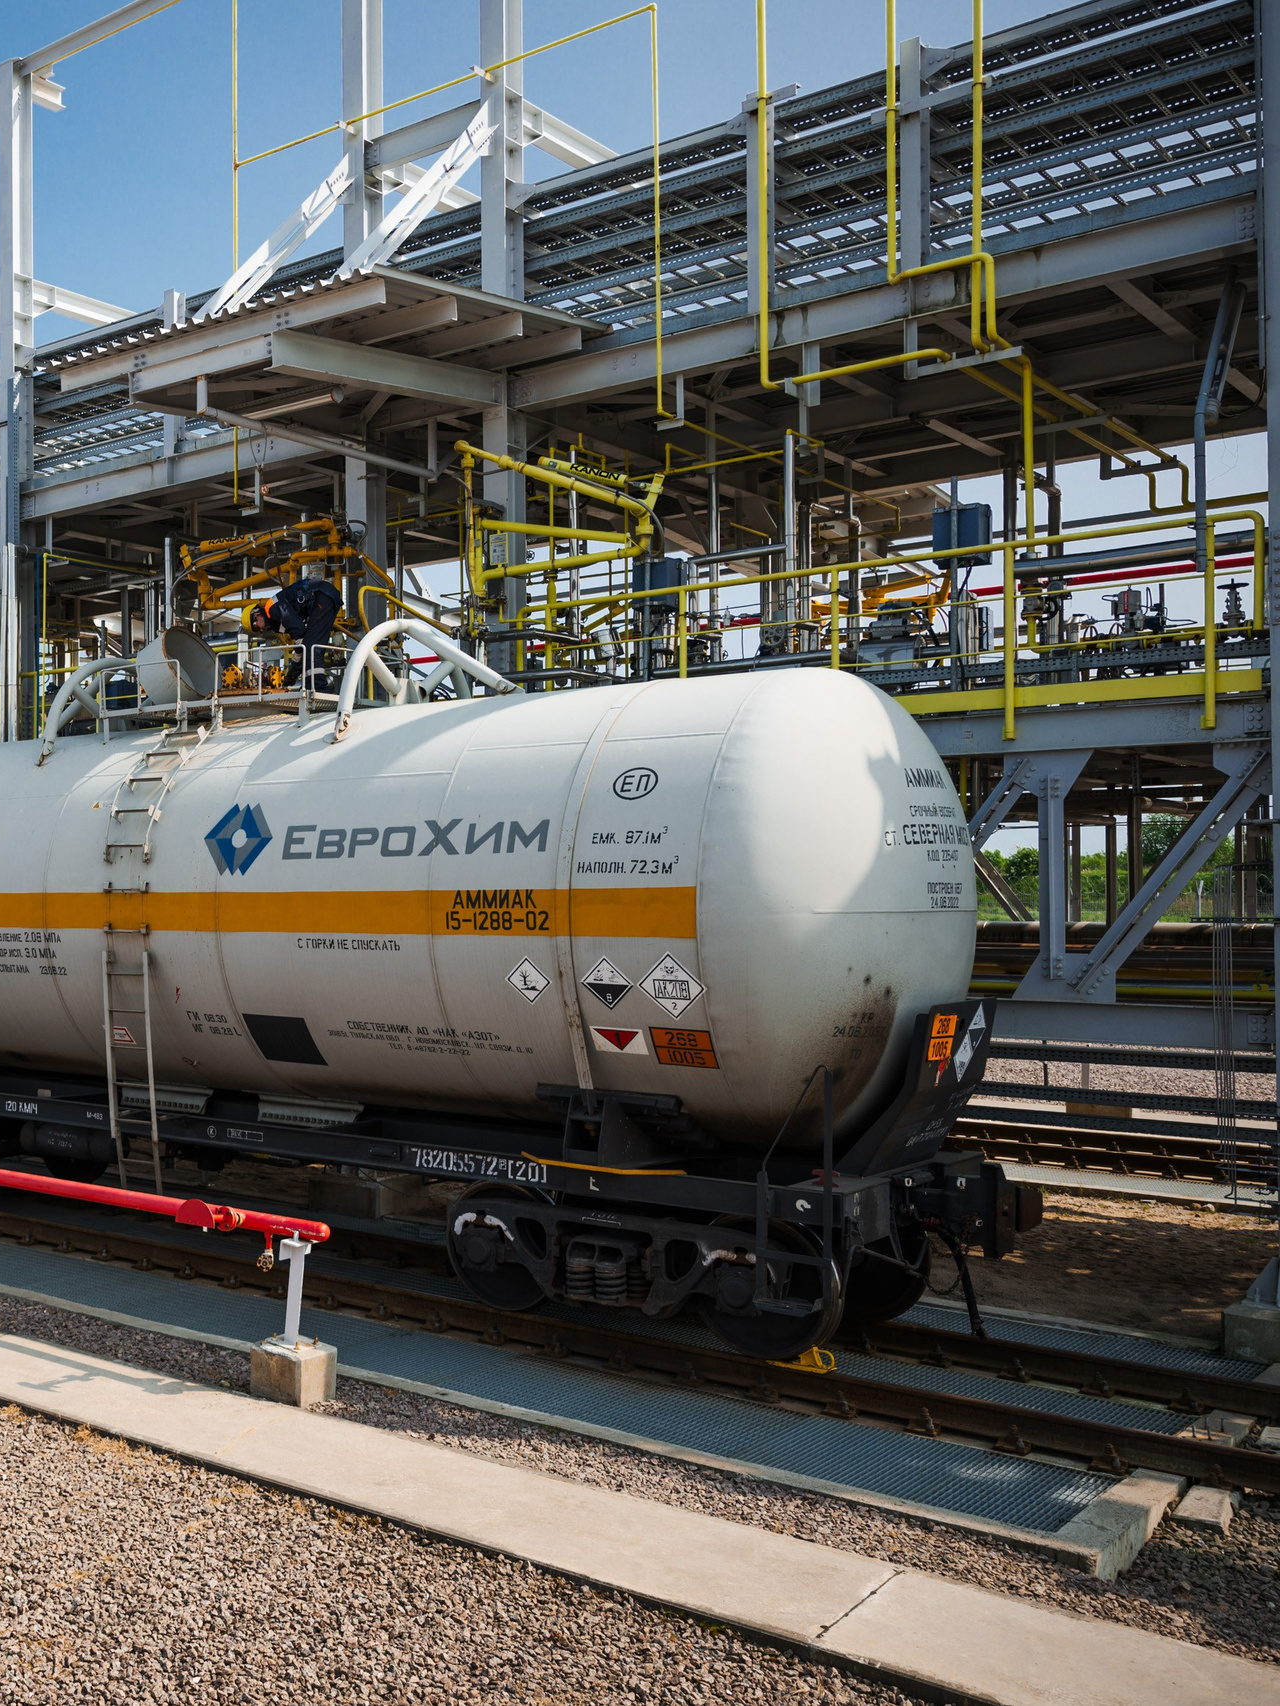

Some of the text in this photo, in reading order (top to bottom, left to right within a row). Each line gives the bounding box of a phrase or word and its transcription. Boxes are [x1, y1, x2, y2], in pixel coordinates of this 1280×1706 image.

[570, 464, 620, 480] KANON
[209, 536, 244, 545] KANON
[903, 824, 957, 845] СЕВЕРНАЯ
[453, 888, 538, 909] АММИАК
[446, 911, 549, 931] 15-1288-02
[25, 947, 38, 958] 3.0
[297, 938, 401, 951] С ГОРКИ НЕ СПУСКАТЬ
[671, 1002, 678, 1011] 2
[347, 1020, 412, 1034] СОБСТВЕННИК
[417, 1026, 429, 1036] АО
[937, 1018, 951, 1035] 268
[664, 1031, 698, 1047] 268
[667, 1050, 706, 1065] 1005
[931, 1041, 948, 1058] 1005
[5, 1100, 17, 1112] 120
[411, 1147, 499, 1176] 78205572
